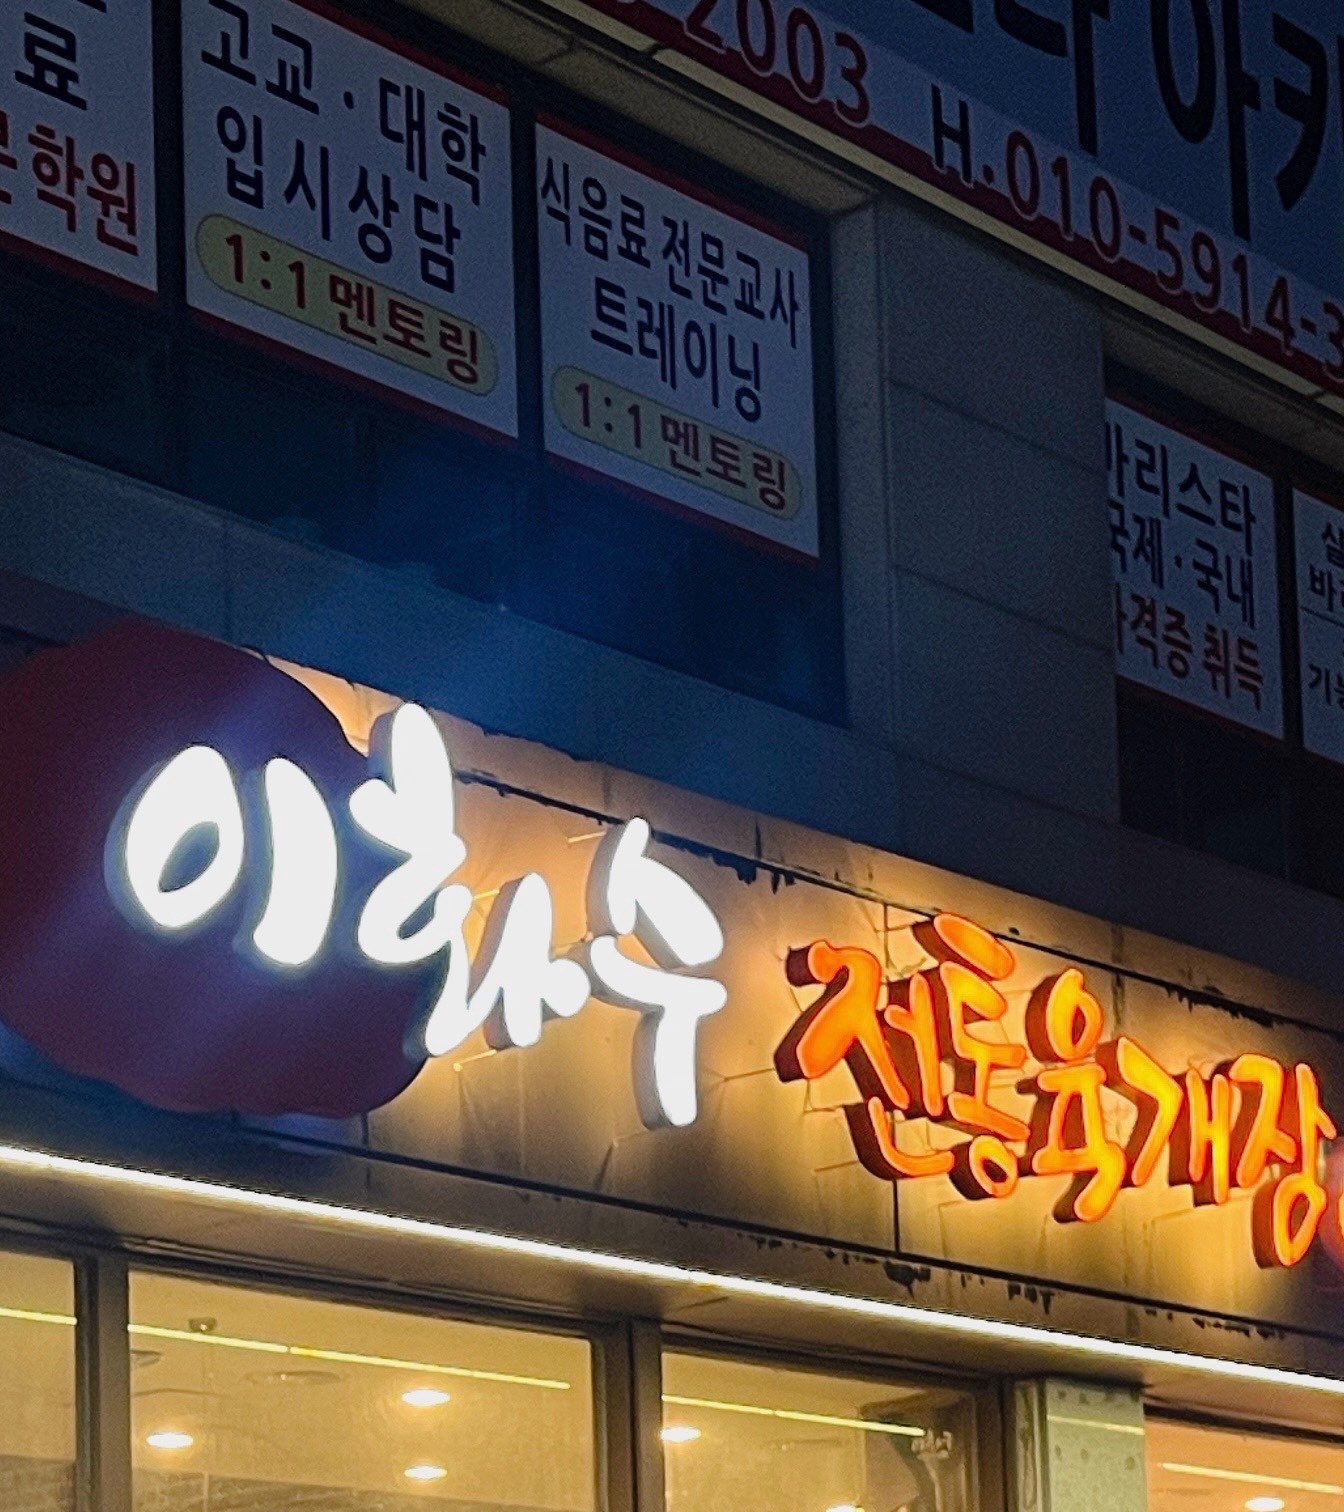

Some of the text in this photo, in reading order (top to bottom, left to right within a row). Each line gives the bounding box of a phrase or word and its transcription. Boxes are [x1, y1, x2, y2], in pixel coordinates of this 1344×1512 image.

[216, 105, 462, 294] 입시상담
[224, 233, 480, 387] 1:1 멘토링
[591, 276, 762, 423] 트레이닝
[575, 383, 787, 511] 1:1 멘토링
[1202, 623, 1264, 711] 취득
[118, 702, 728, 1127] 이화수
[776, 912, 1336, 1270] 전통육개장
